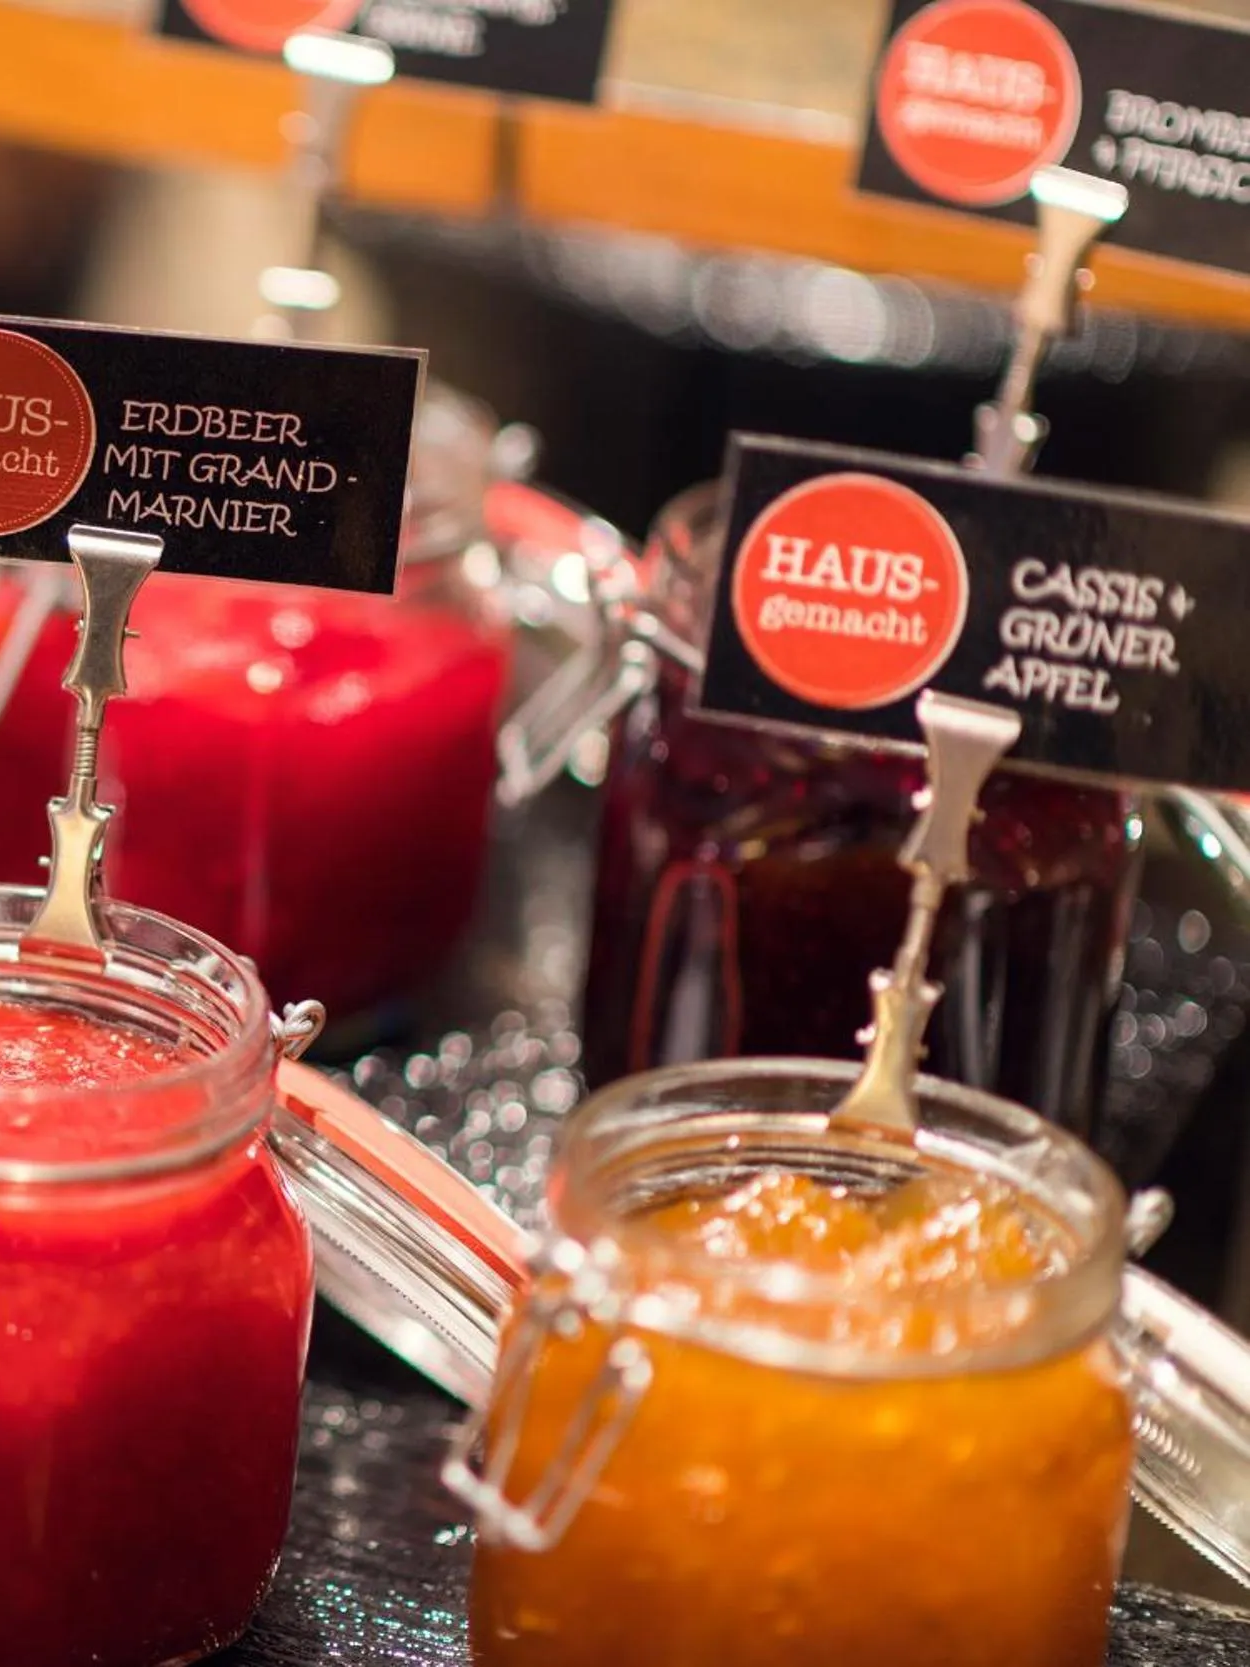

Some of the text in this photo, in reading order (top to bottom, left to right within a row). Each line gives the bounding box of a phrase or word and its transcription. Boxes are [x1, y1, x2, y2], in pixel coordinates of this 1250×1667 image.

[121, 400, 307, 447] ERDBEER
[104, 444, 181, 481] MIT
[107, 490, 297, 537] MARNIER
[761, 534, 939, 600] HAUS-
[1011, 557, 1165, 619] CASSIS
[759, 594, 928, 645] gemacht
[1000, 608, 1179, 674] GRÜNER
[982, 655, 1120, 712] APFEL
